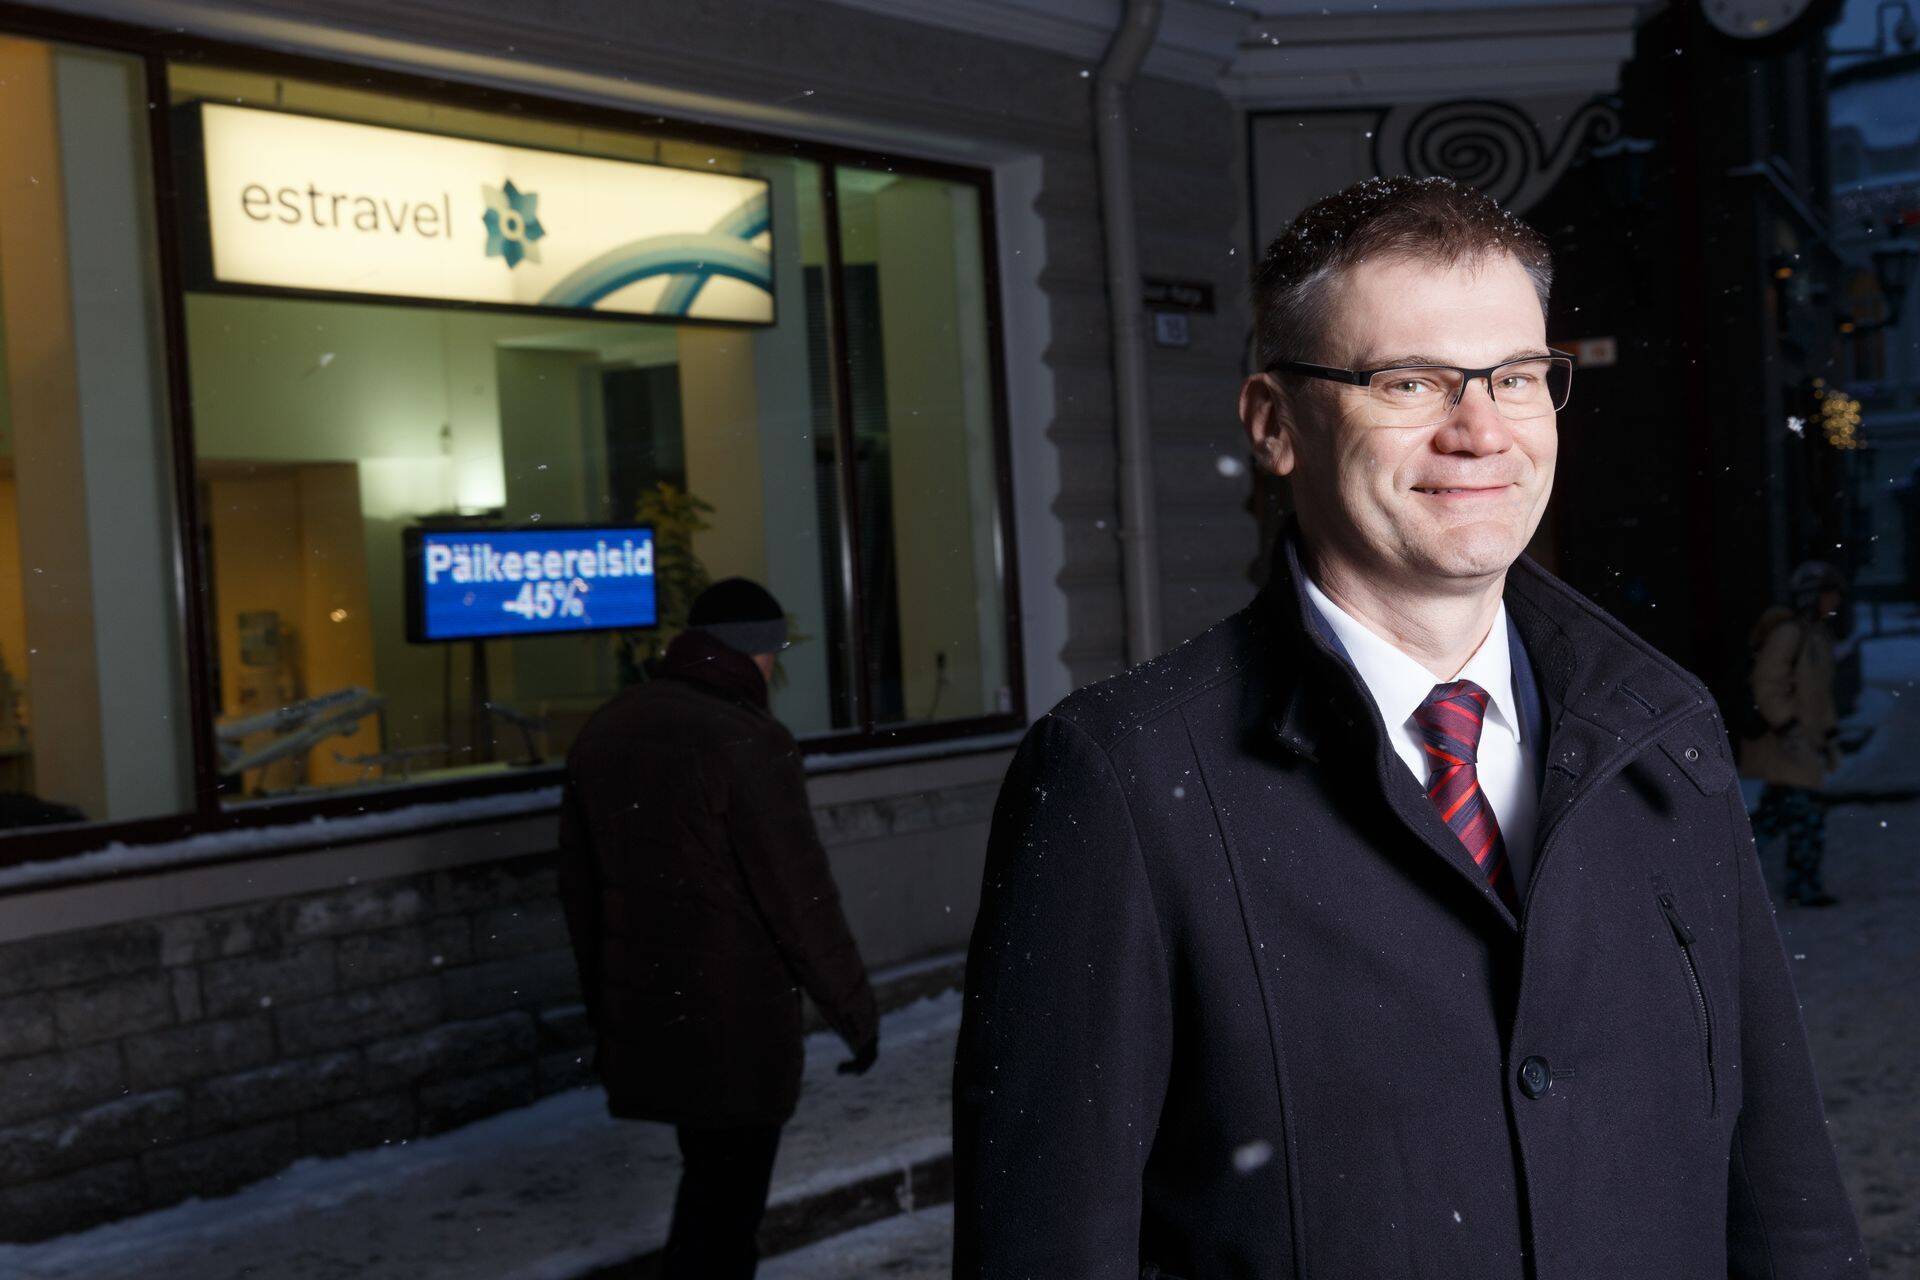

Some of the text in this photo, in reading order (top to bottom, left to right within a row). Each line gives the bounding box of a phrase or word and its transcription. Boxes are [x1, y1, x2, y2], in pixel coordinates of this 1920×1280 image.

[241, 182, 452, 239] estravel
[425, 540, 653, 584] Päikesereisid
[502, 580, 585, 620] -45%
